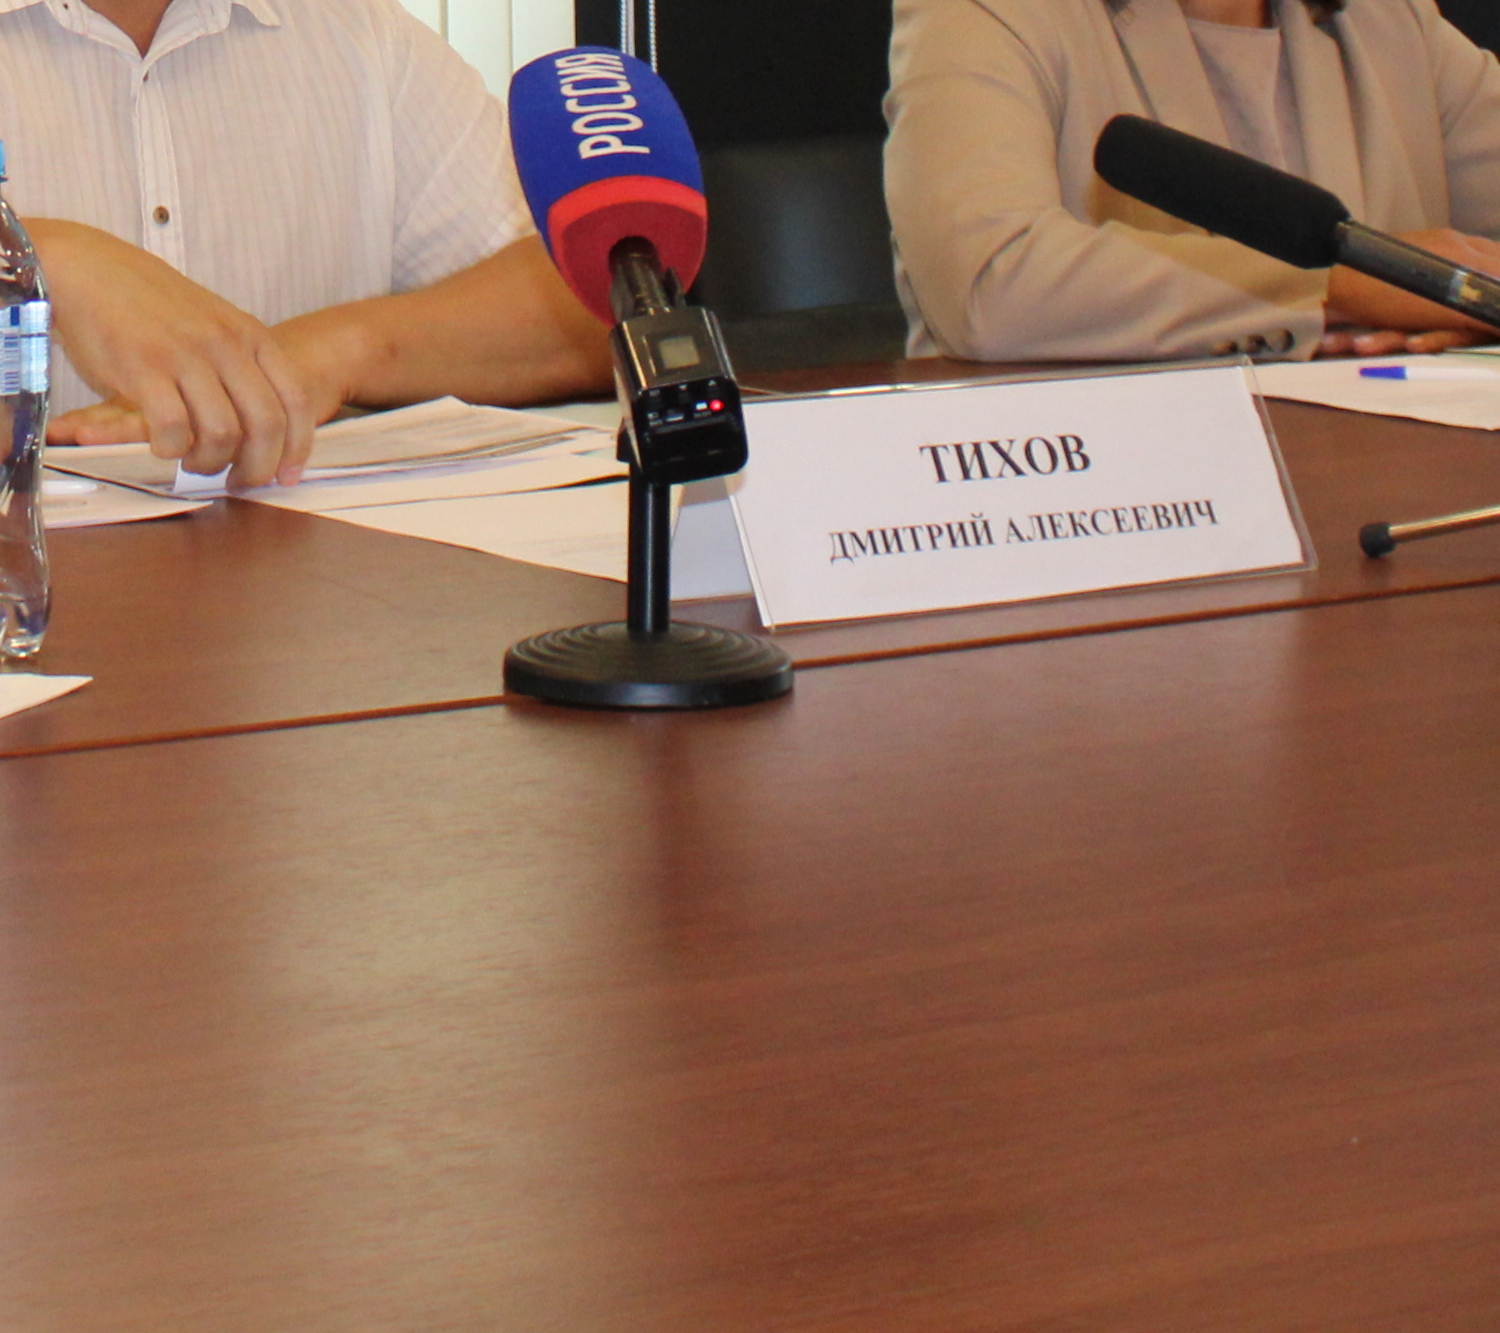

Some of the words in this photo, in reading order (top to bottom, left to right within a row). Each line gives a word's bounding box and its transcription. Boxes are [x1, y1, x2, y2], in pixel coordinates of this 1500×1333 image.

[555, 53, 651, 160] РОССИЯ
[920, 434, 1093, 485] ТИХОВ
[829, 513, 994, 565] ДМИТРИЙ
[1005, 500, 1219, 546] АЛЕКСЕЕВИЧ
